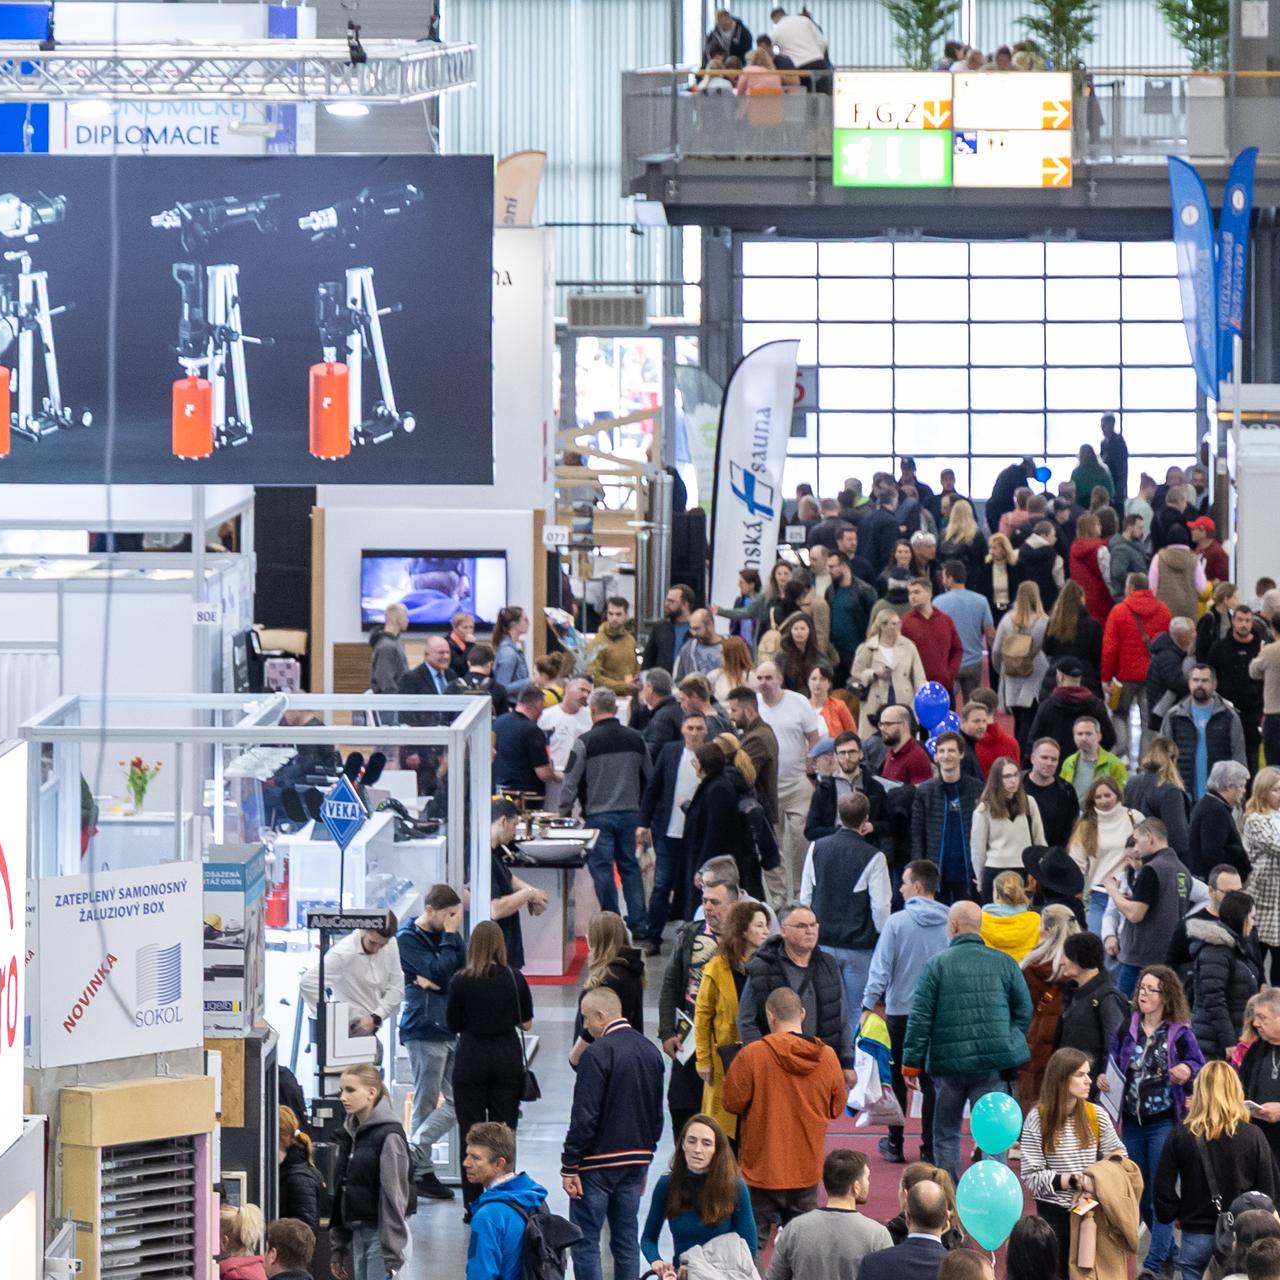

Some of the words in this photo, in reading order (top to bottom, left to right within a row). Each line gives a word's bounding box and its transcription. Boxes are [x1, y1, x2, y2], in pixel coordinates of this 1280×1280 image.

[76, 125, 220, 146] DIPLOMACIE
[751, 406, 772, 473] sauna
[325, 801, 360, 820] VEKA
[55, 884, 117, 908] ZATEPLENÝ
[118, 877, 188, 901] SAMONOSNÝ
[78, 902, 141, 923] ŽALUZIOVÝ
[143, 900, 165, 915] BOX
[310, 916, 385, 930] AluConnect
[62, 952, 119, 1036] NOVINKA
[135, 1006, 184, 1028] SOKOL
